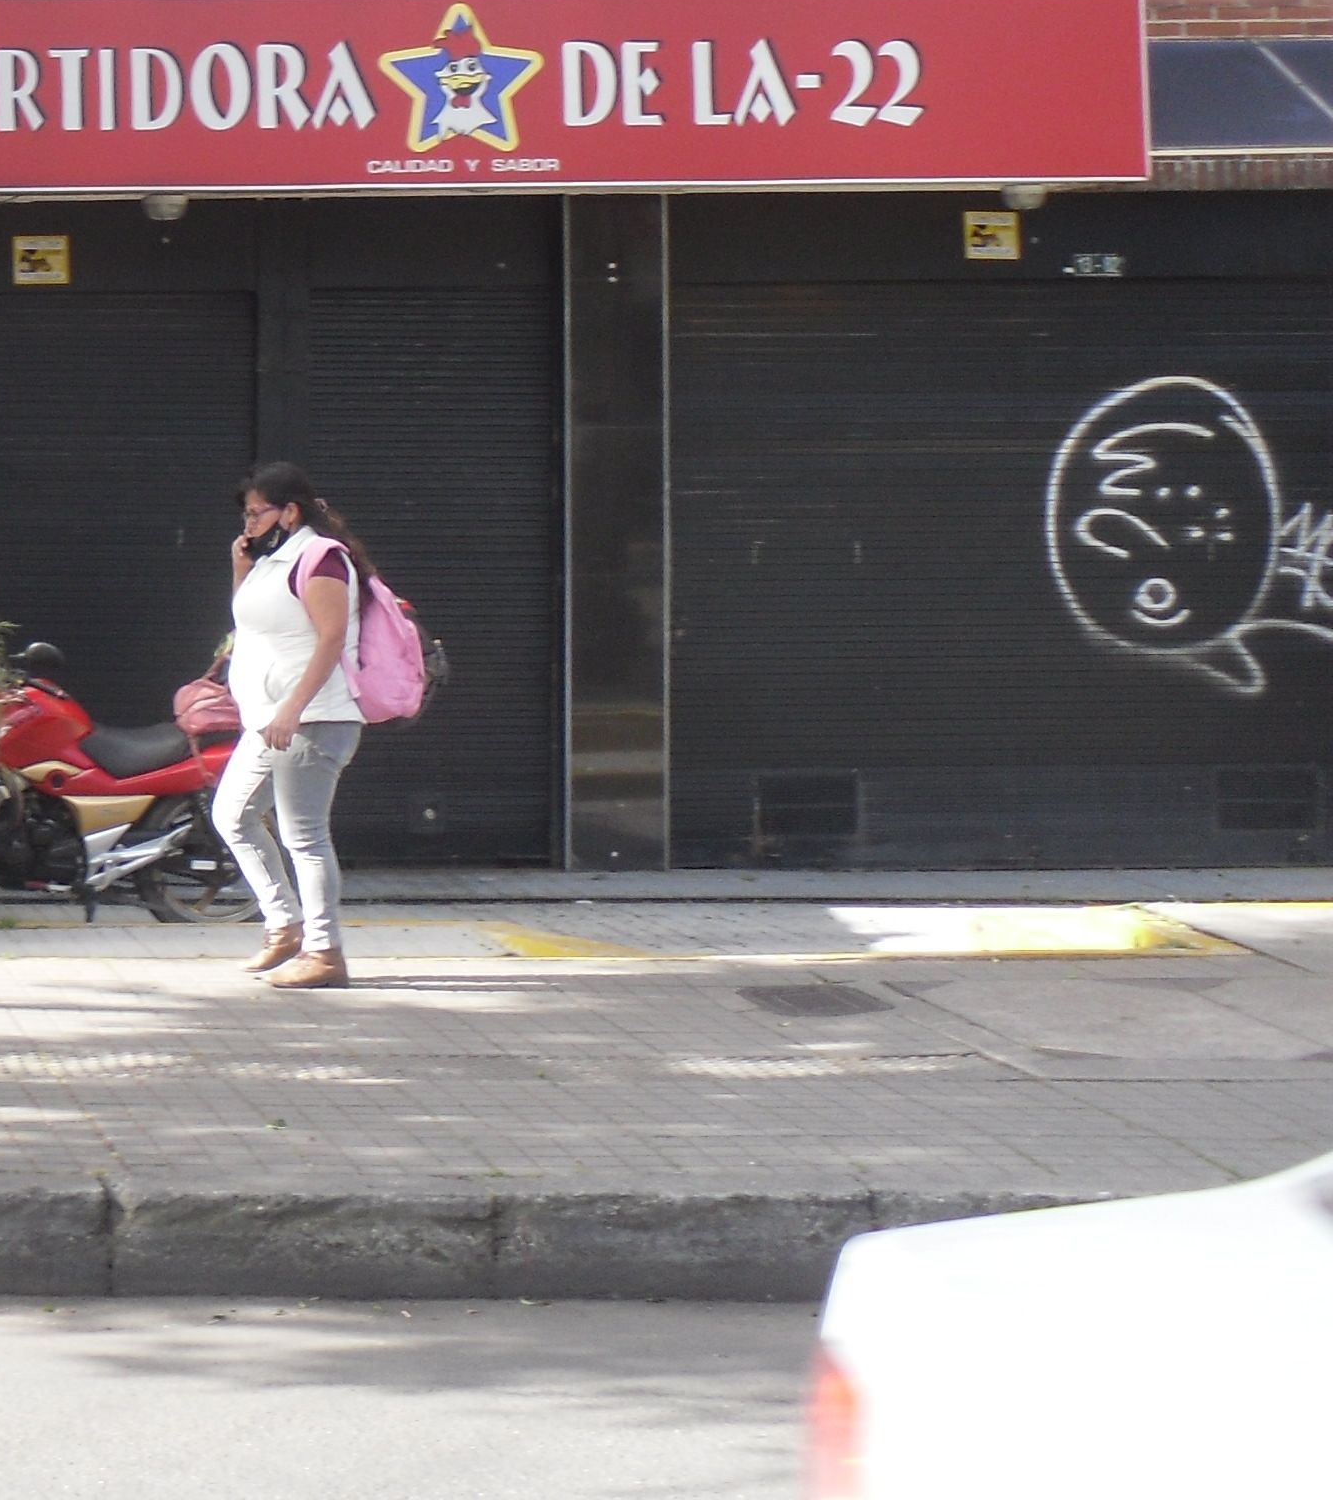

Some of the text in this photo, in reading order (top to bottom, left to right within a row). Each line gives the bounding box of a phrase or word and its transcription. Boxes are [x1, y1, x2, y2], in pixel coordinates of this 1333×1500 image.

[561, 40, 666, 127] DE
[692, 37, 925, 127] LA-22
[367, 158, 560, 174] CALIDAD Y SABOR
